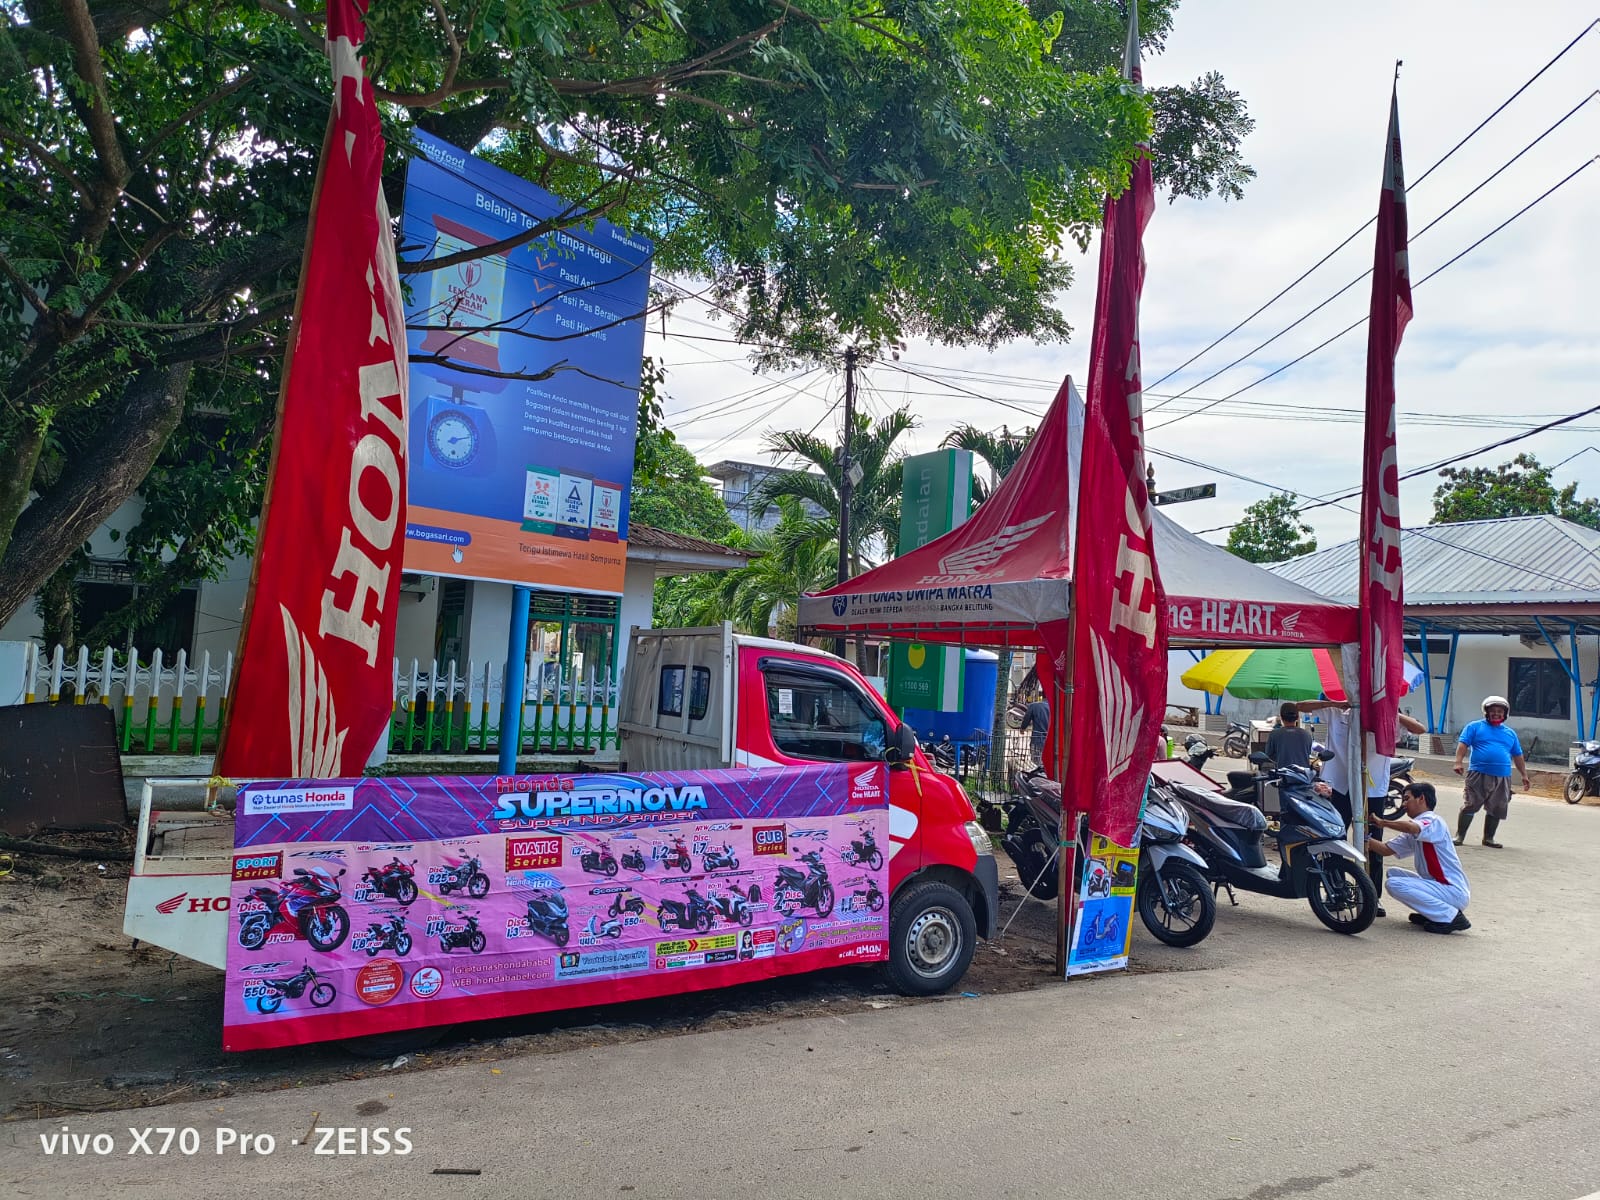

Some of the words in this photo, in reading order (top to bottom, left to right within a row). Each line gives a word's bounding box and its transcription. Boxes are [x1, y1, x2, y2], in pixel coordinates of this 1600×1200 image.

[417, 141, 466, 169] ndofood
[475, 193, 517, 223] Belanja
[556, 229, 585, 253] Tanpa
[611, 229, 650, 255] bogasari
[559, 268, 579, 282] Pasti
[557, 291, 577, 307] Pasti
[579, 299, 593, 314] Pas
[555, 313, 576, 330] Pasti
[524, 411, 548, 424] Dengan
[915, 467, 931, 548] adaian
[406, 529, 465, 543] w.bogasari.com
[519, 543, 541, 555] Terigu
[542, 546, 572, 557] Istimewa
[573, 551, 590, 560] Hasil
[590, 553, 621, 565] Sempurna
[916, 570, 1005, 584] HONDA
[947, 584, 992, 600] MATRA
[940, 604, 963, 612] BANGKA
[964, 603, 993, 611] BELITUNG
[1168, 604, 1193, 630] ne
[1201, 601, 1278, 636] HEART.
[1281, 630, 1305, 638] HONDA
[496, 777, 575, 793] Honda
[265, 794, 304, 804] tunas
[305, 791, 346, 802] Honda
[493, 785, 709, 819] SUPERNOVA
[852, 791, 863, 799] One
[498, 817, 575, 830] Super
[580, 811, 699, 826] November
[756, 831, 783, 844] CUB
[513, 841, 559, 856] MATIC
[757, 844, 783, 852] Series
[236, 856, 278, 869] SPORT
[513, 856, 557, 867] Series
[235, 868, 276, 878] Series
[428, 873, 448, 884] 825
[239, 902, 267, 913] Disc.
[773, 891, 785, 911] 2
[507, 918, 530, 927] Disc.
[624, 916, 639, 926] 550
[238, 914, 265, 948] 6
[506, 927, 519, 938] 1,3
[578, 937, 596, 945] 440
[243, 986, 267, 998] 550
